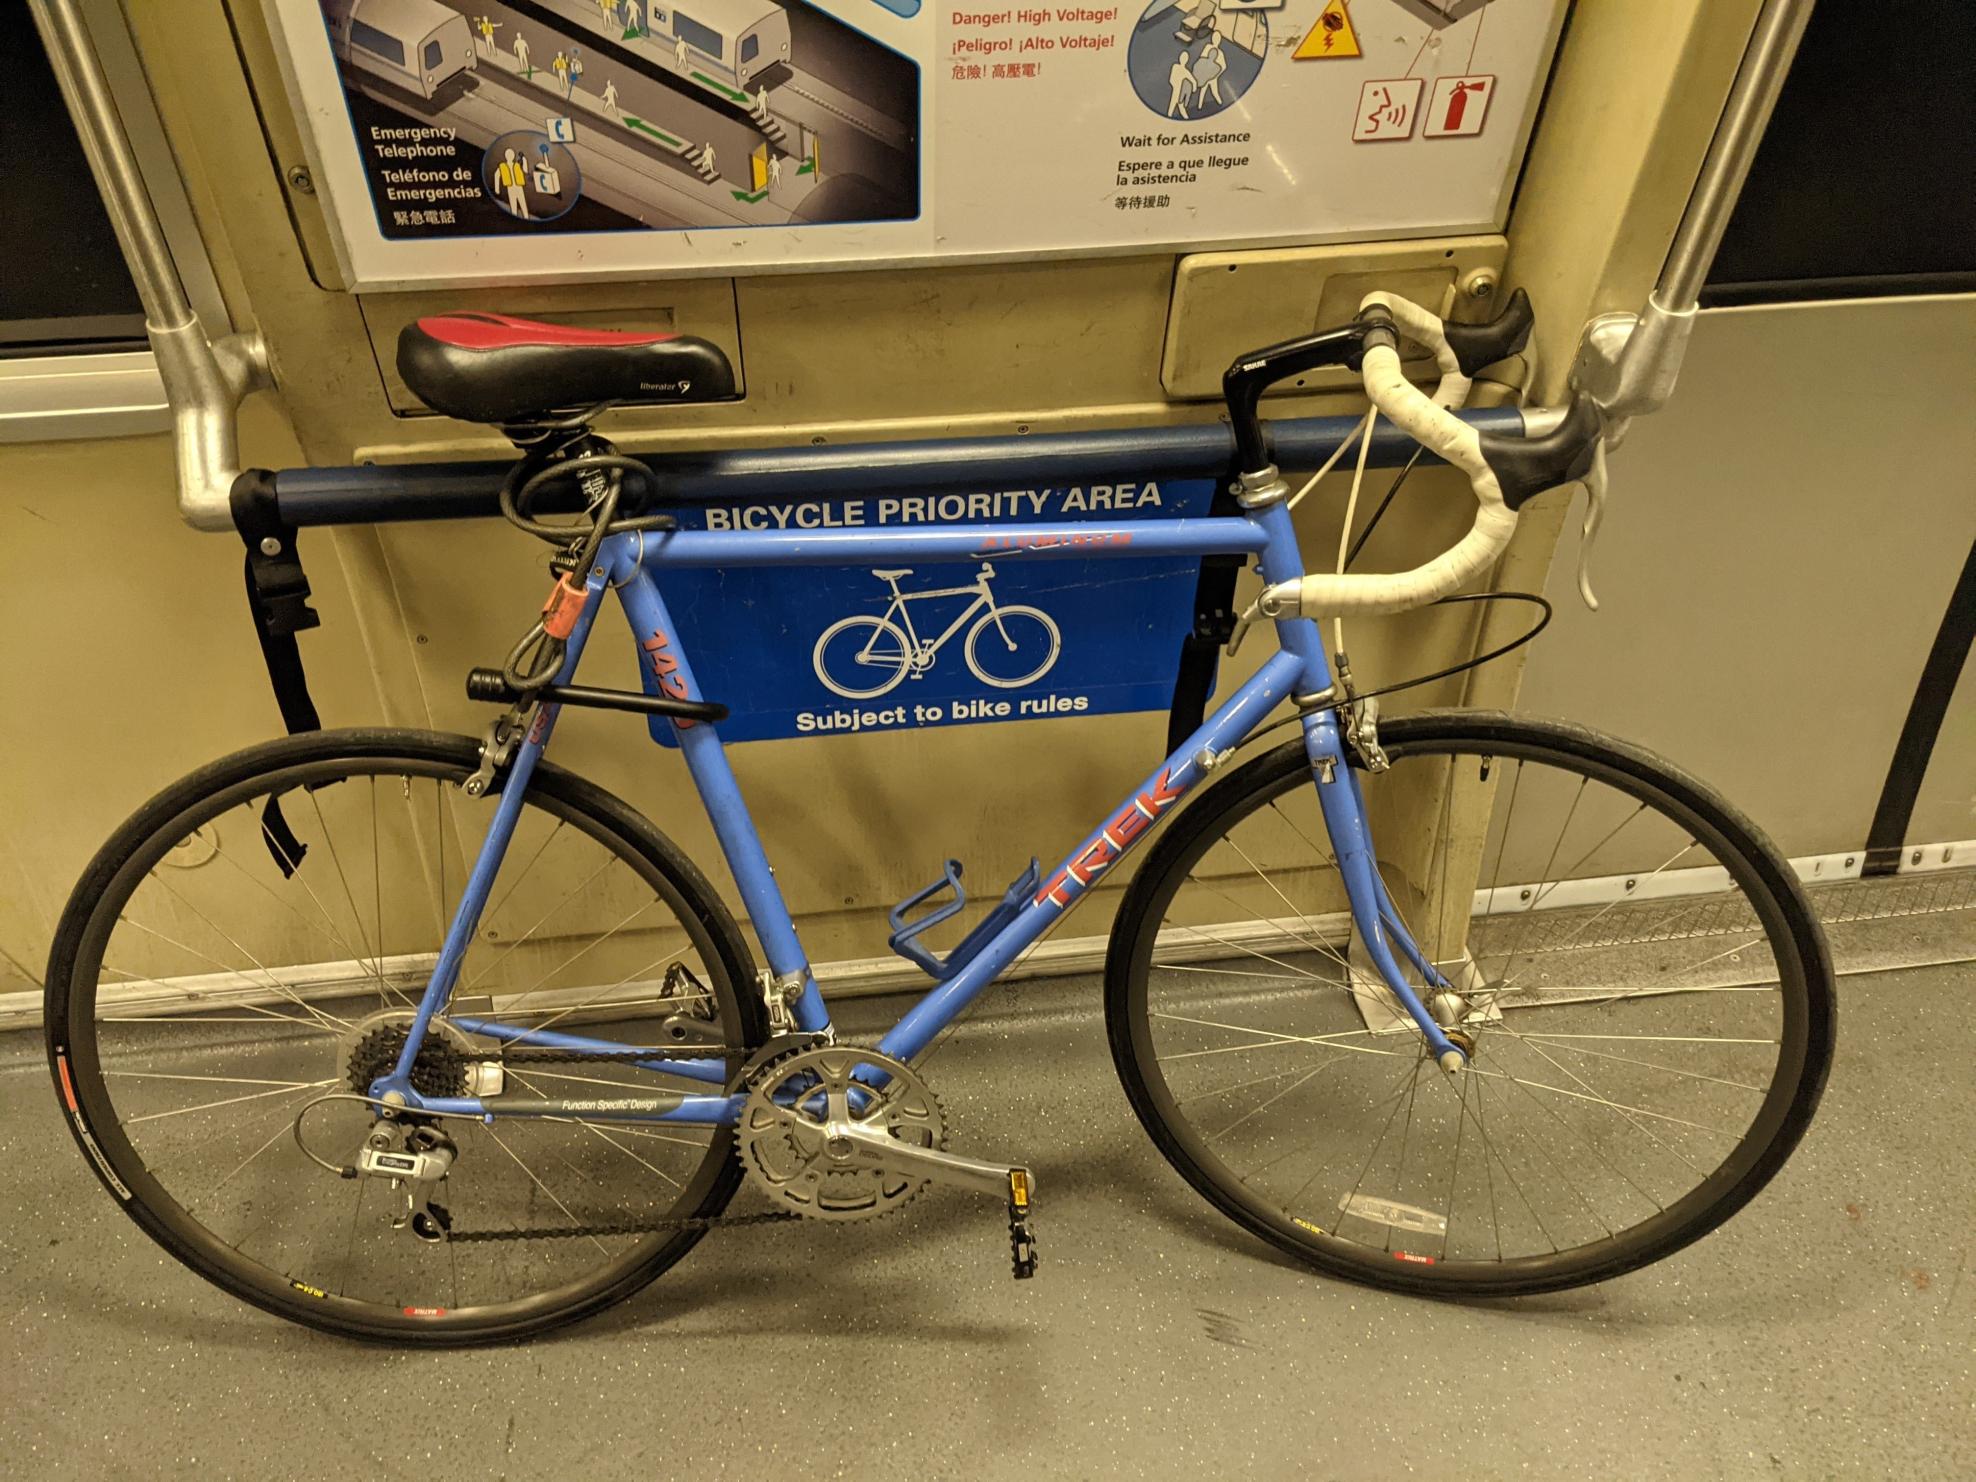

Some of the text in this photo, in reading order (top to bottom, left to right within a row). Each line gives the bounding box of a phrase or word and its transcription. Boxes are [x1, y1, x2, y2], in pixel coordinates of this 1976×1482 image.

[952, 8, 1118, 27] Danger! High Voltage!
[952, 35, 1115, 54] ¡Peligro! ¡Alto Voltaje!
[370, 126, 456, 142] Emergency
[1120, 132, 1251, 148] Wait for Assistance
[374, 143, 456, 160] Telephone
[1117, 155, 1249, 174] Espere a que llegue
[381, 166, 473, 183] Teléfono de
[1115, 171, 1197, 186] la asistencia
[386, 184, 482, 202] Emergencias
[705, 482, 1163, 531] BICYCLE PRIORITY AREA
[796, 694, 1089, 732] Subject to bike rules
[1033, 767, 1188, 909] TREK
[562, 1099, 596, 1111] Function
[630, 1099, 657, 1112] Design
